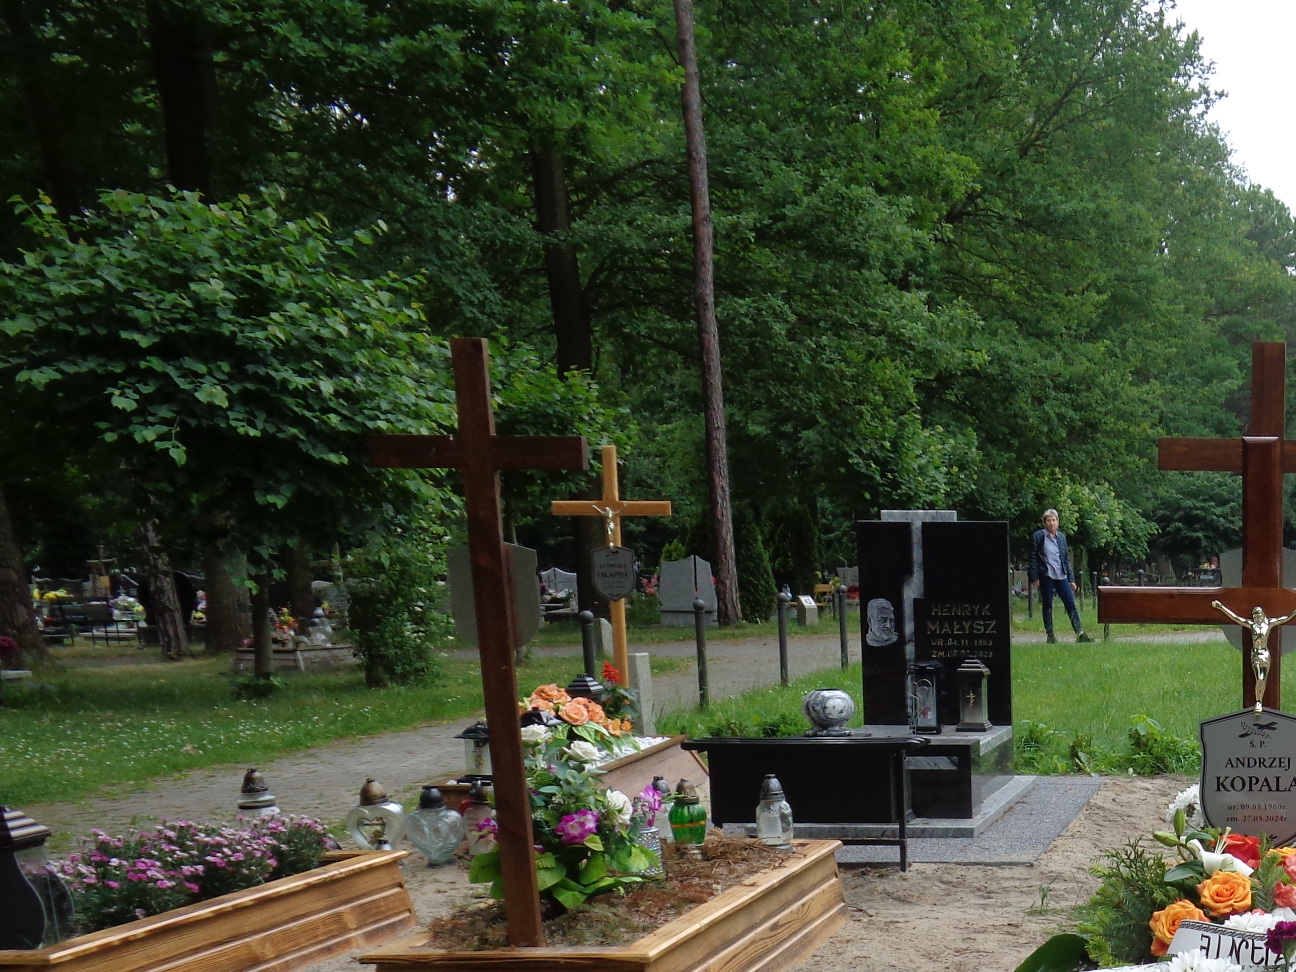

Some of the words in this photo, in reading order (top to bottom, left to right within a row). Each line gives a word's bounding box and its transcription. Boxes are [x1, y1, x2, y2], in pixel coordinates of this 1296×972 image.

[932, 603, 991, 616] HENRYK
[927, 620, 997, 634] MAŁYSZ
[1224, 756, 1292, 771] ANDRZEJ
